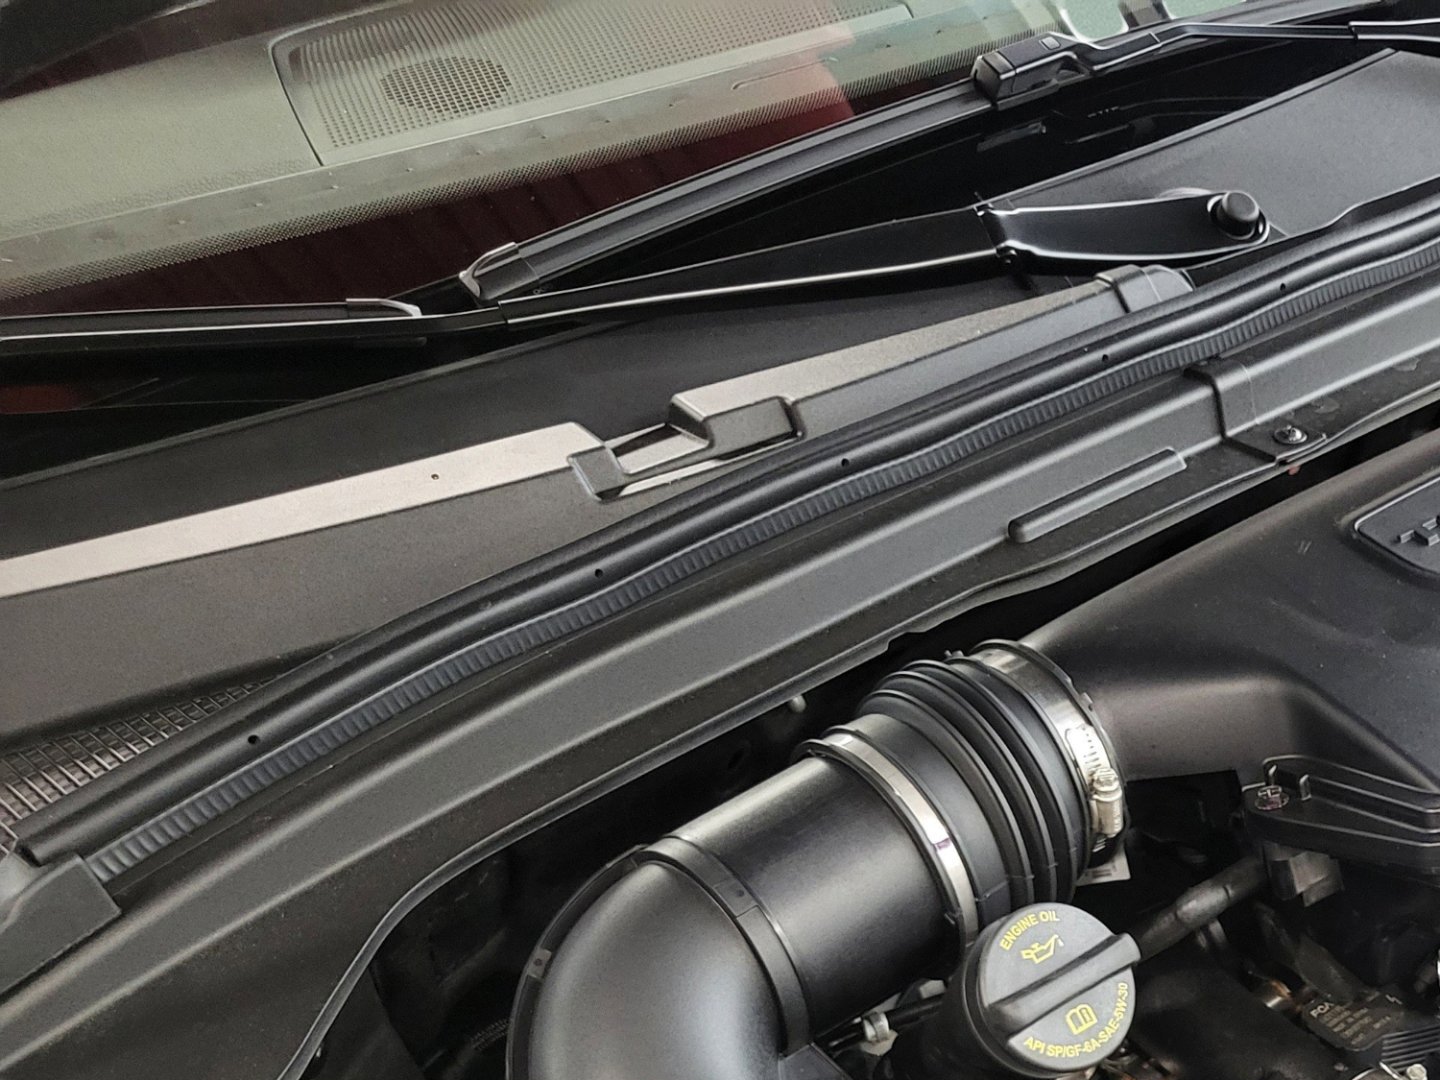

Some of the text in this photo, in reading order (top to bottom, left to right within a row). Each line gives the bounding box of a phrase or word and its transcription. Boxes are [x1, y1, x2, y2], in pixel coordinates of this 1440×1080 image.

[999, 910, 1060, 951] ENGINE OIL
[1023, 1036, 1046, 1053] API
